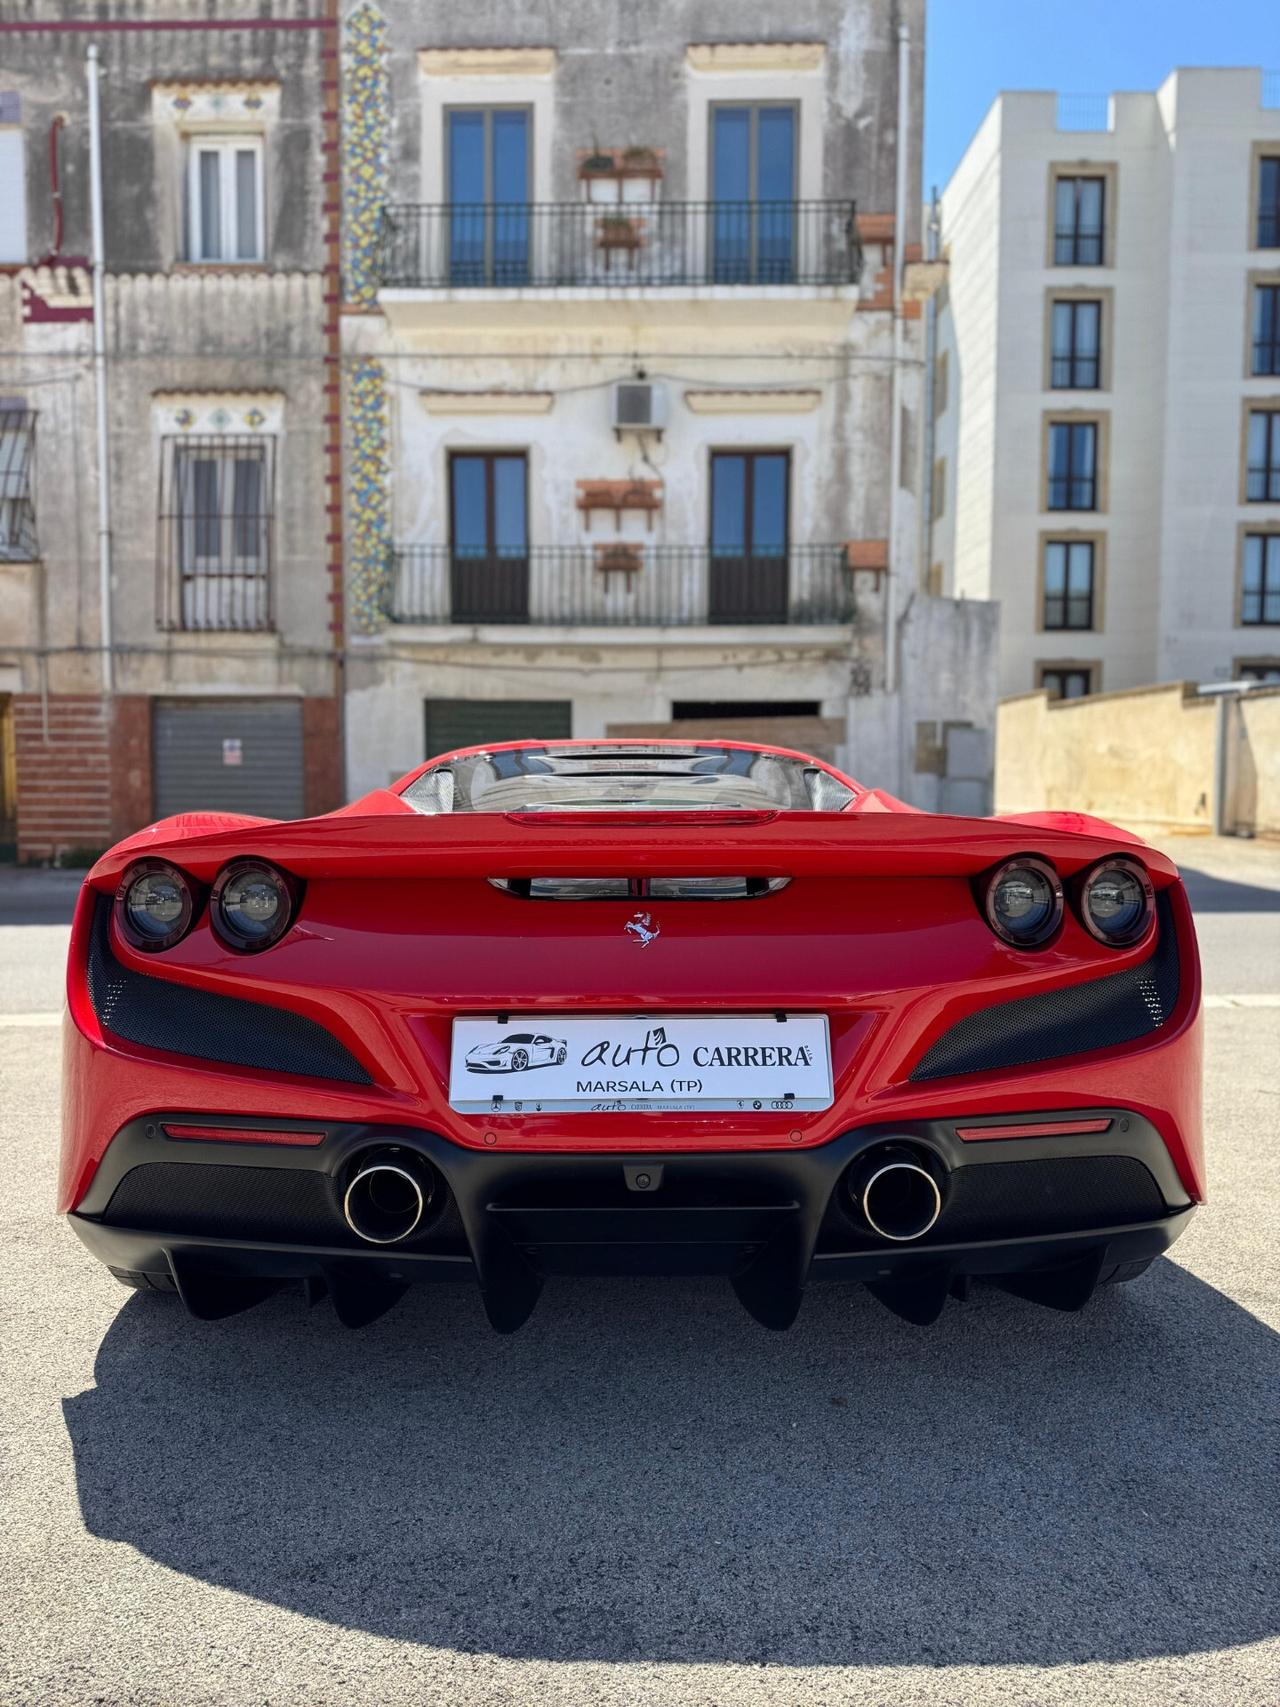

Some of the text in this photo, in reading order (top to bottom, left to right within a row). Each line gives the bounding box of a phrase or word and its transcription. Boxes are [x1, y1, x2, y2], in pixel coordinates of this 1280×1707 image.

[580, 1030, 812, 1068] auto CARRERA
[576, 1078, 703, 1093] MARSALA (TP)
